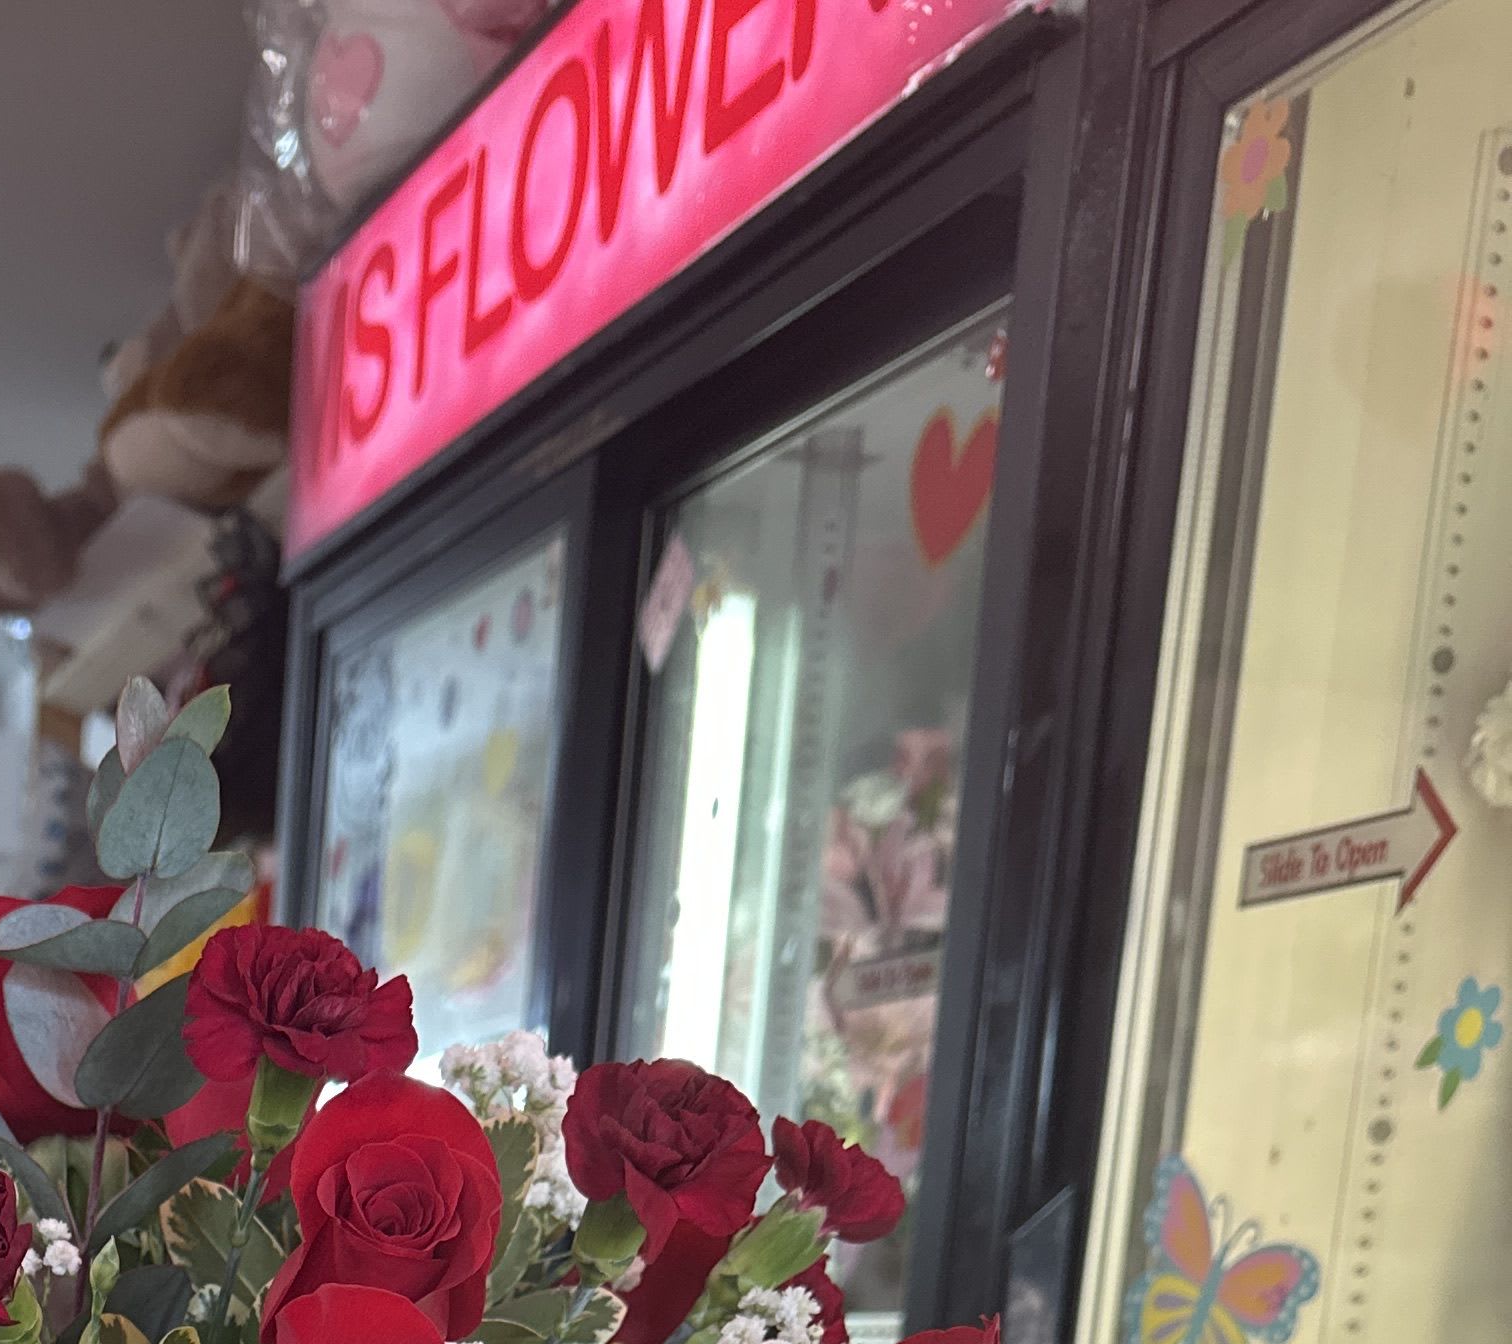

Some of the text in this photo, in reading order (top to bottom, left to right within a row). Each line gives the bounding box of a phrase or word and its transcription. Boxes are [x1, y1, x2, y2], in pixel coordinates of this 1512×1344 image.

[1259, 836, 1388, 887] Slide To Open
